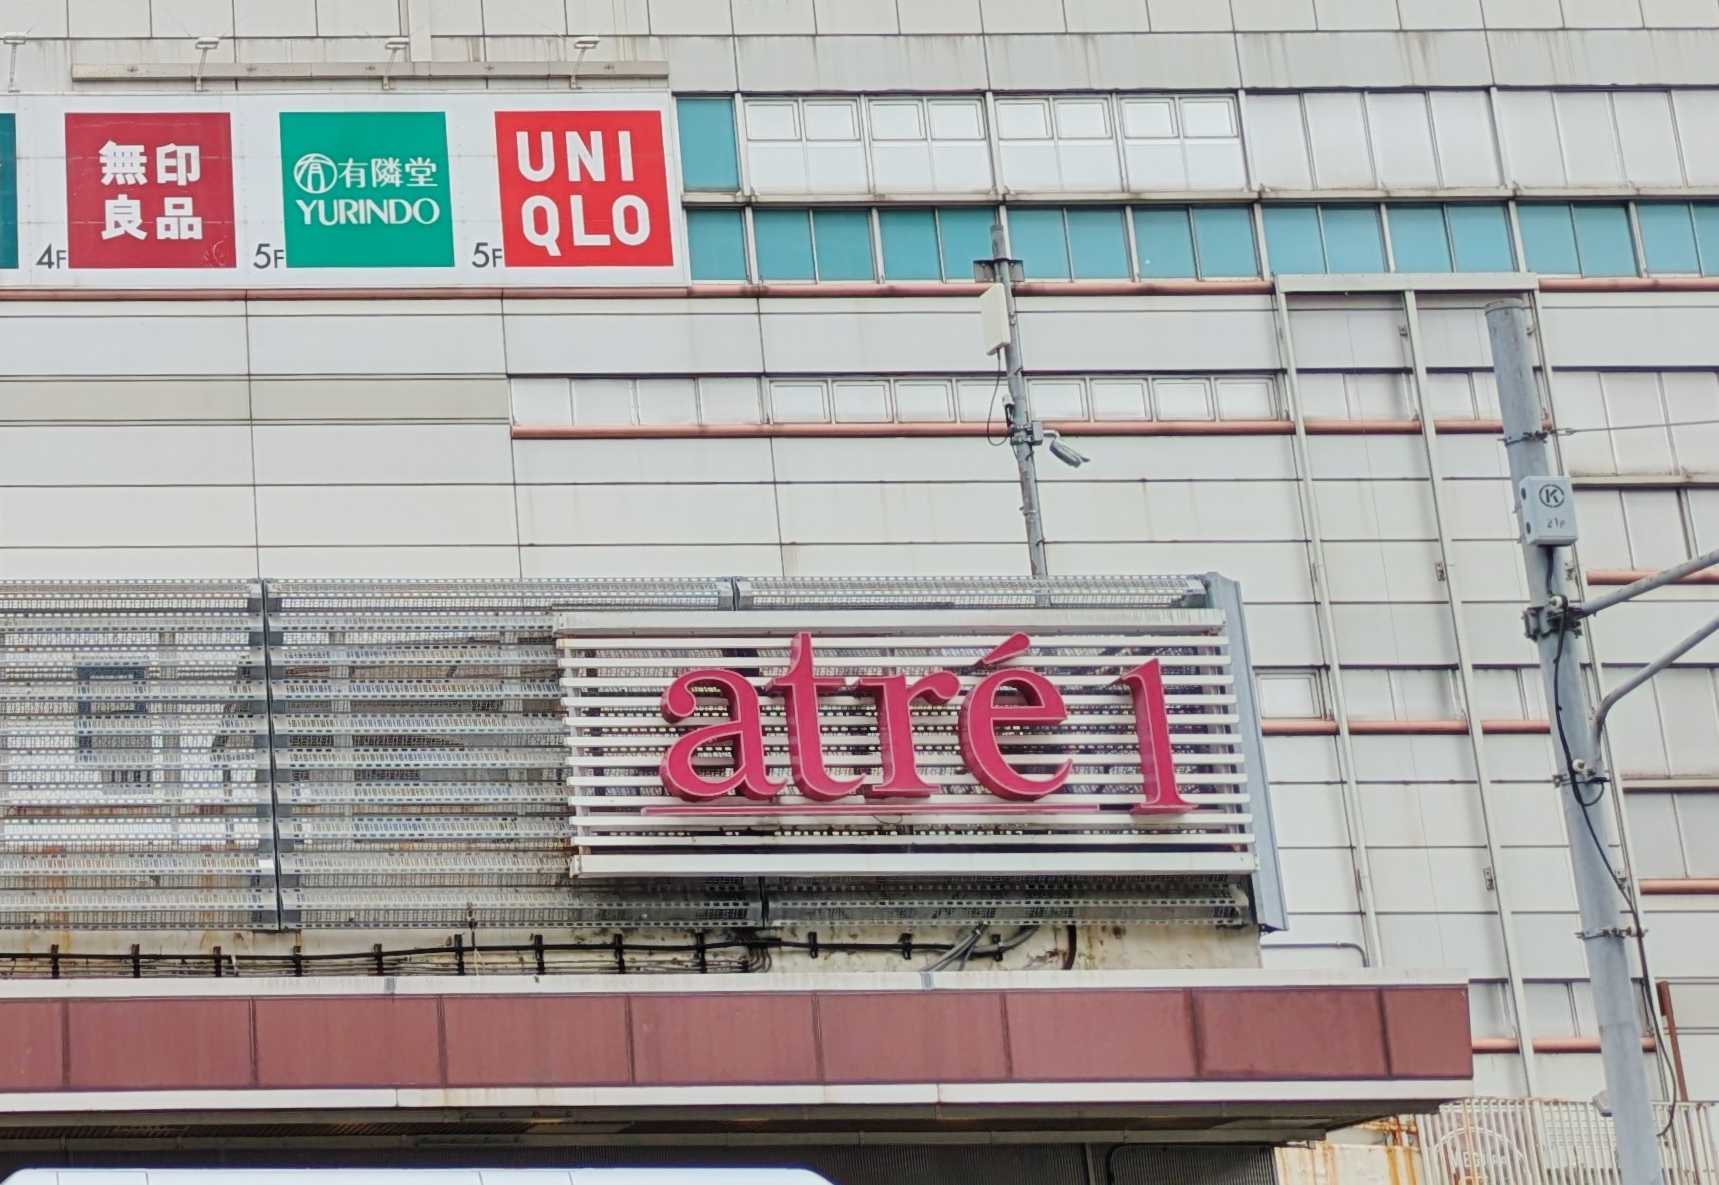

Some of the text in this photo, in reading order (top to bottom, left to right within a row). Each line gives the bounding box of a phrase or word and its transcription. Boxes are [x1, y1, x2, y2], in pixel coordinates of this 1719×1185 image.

[98, 140, 201, 186] 無印
[337, 157, 438, 188] 有隣堂
[515, 130, 635, 182] UNI
[101, 194, 203, 240] 良品
[295, 198, 441, 226] YURINDO
[521, 194, 651, 256] QLO
[35, 243, 67, 269] 4F
[253, 243, 284, 269] 5F
[471, 242, 503, 268] 5F
[659, 630, 1074, 802] atré
